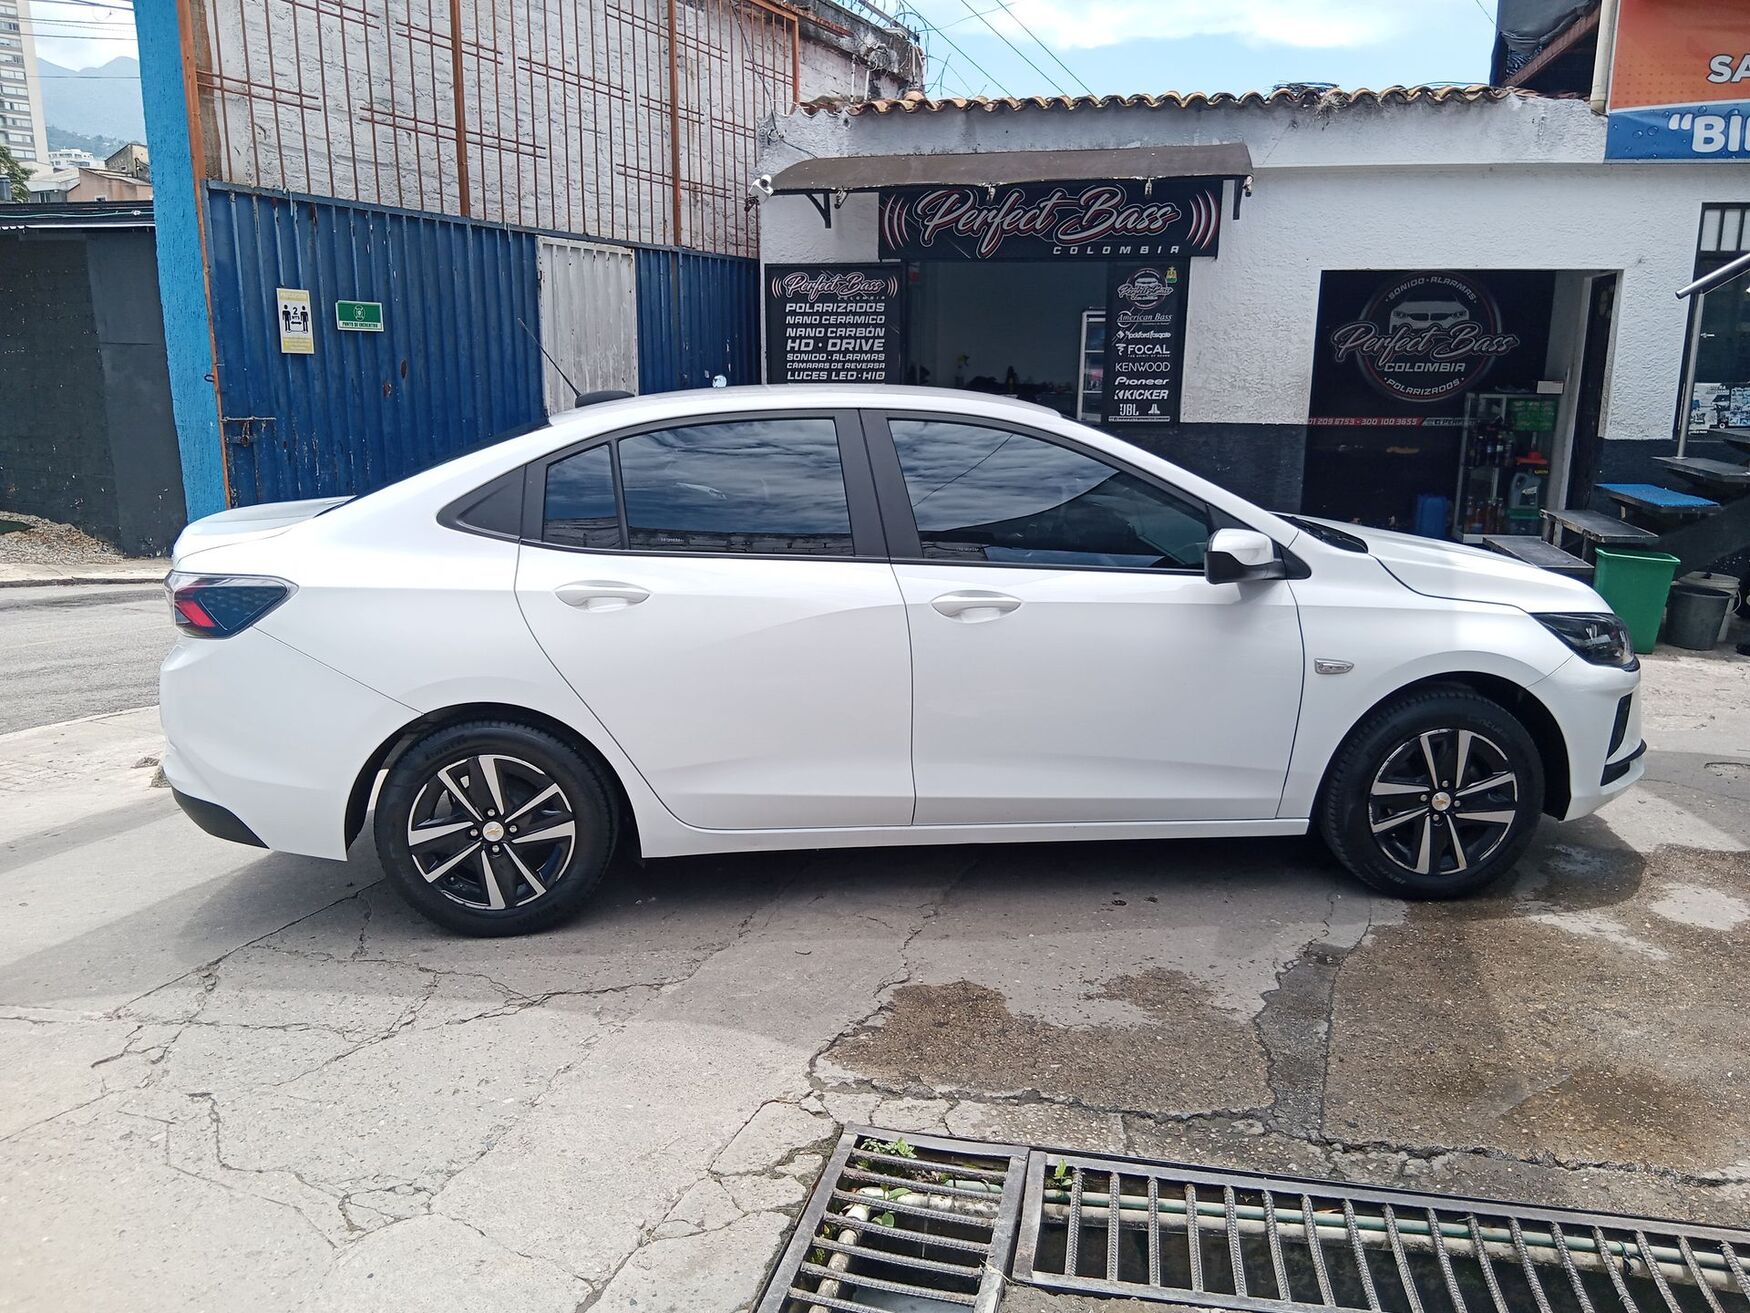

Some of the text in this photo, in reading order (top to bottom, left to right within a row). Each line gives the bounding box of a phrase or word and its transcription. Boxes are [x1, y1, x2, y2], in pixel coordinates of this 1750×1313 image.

[914, 186, 1181, 256] Perfect Bass
[1053, 246, 1180, 255] COLOMBIA
[783, 272, 885, 302] Perfect Bass
[292, 306, 299, 315] 2
[785, 303, 885, 313] POLARIZADOS
[785, 313, 885, 324] NANO CERÁMICO
[1119, 312, 1173, 322] American Bass
[786, 325, 885, 337] NANO CARBÓN
[786, 339, 885, 351] HD DRIVE
[1128, 344, 1170, 354] FOCAL
[1333, 322, 1518, 367] Perfect Bass
[1115, 362, 1171, 371] KENWOOD
[1384, 362, 1465, 372] COLOMBIA
[787, 371, 828, 380] LUCES
[1114, 376, 1169, 385] Pioneer
[1123, 389, 1169, 399] KICKER
[1119, 403, 1139, 416] JBL
